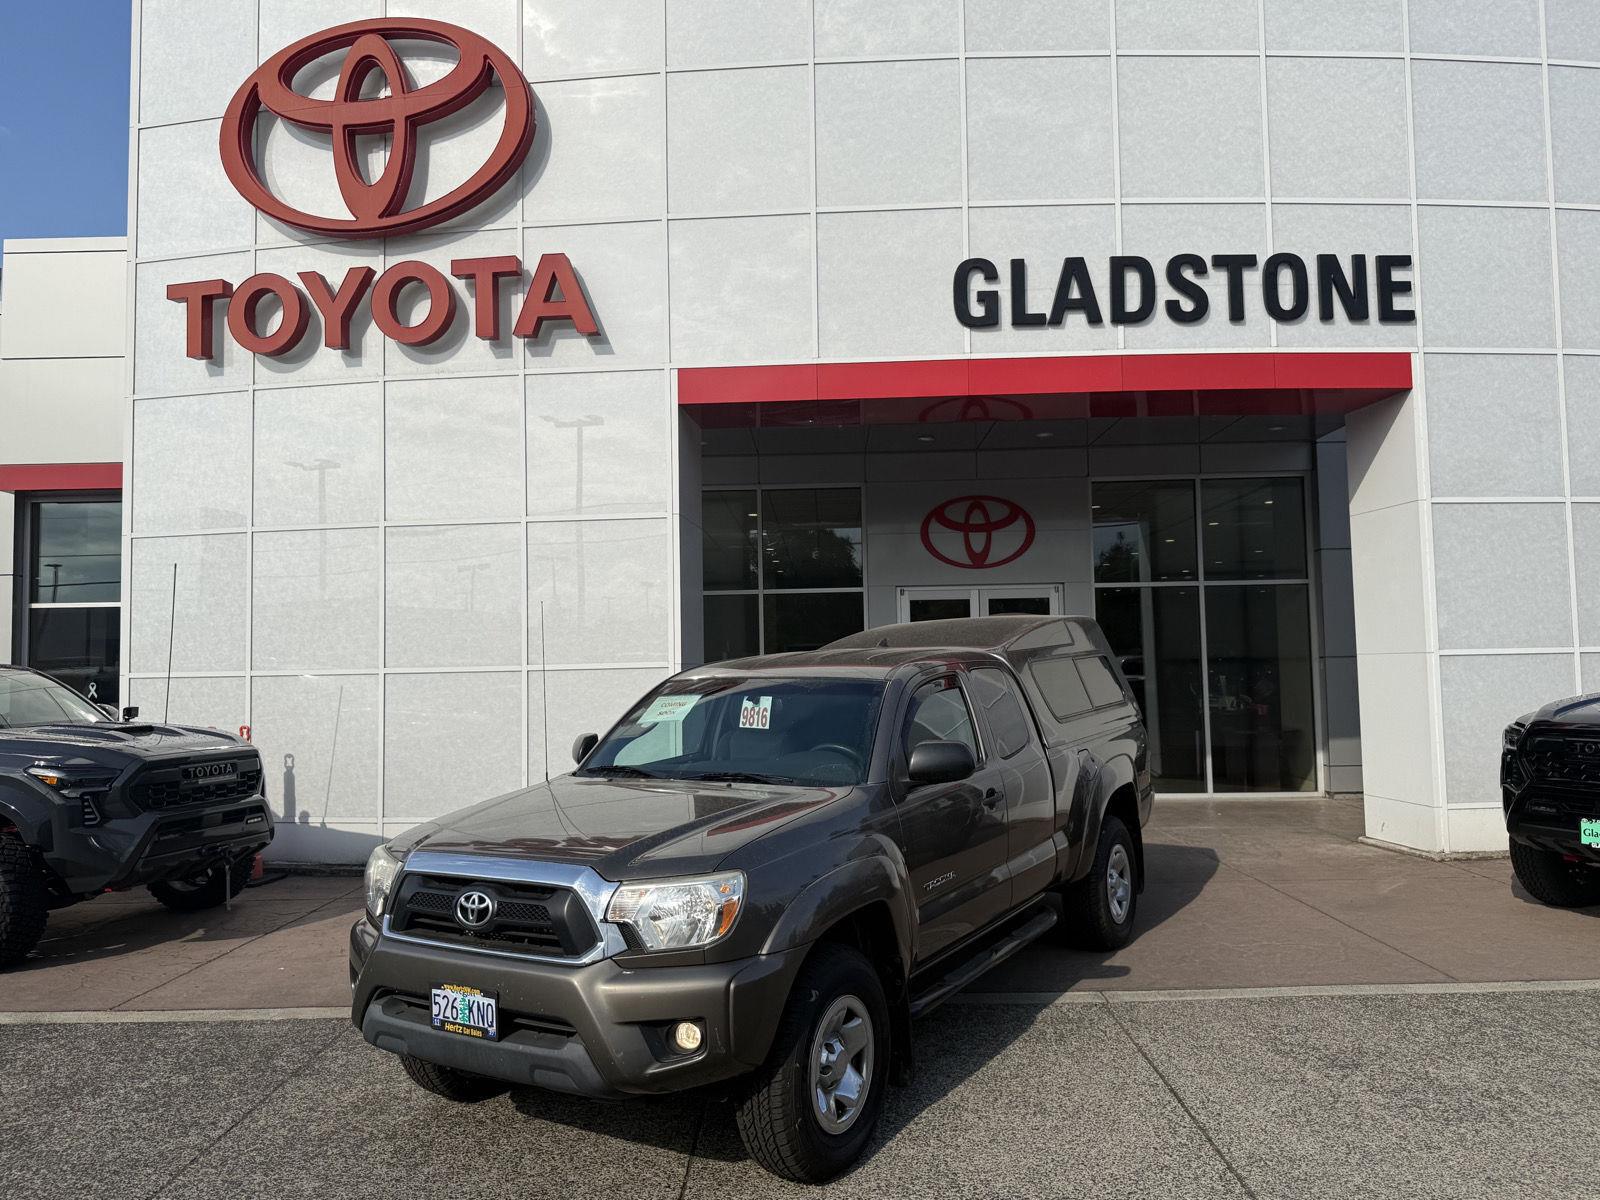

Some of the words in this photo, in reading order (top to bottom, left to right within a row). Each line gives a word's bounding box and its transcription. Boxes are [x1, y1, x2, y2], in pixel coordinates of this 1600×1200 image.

[952, 251, 1417, 328] GLADSTONE
[166, 252, 602, 361] TOYOTA
[741, 706, 769, 728] 9816
[188, 763, 234, 779] TOYOTA
[432, 993, 459, 1020] 526
[467, 999, 495, 1028] KNQ
[444, 1022, 463, 1033] Hertz
